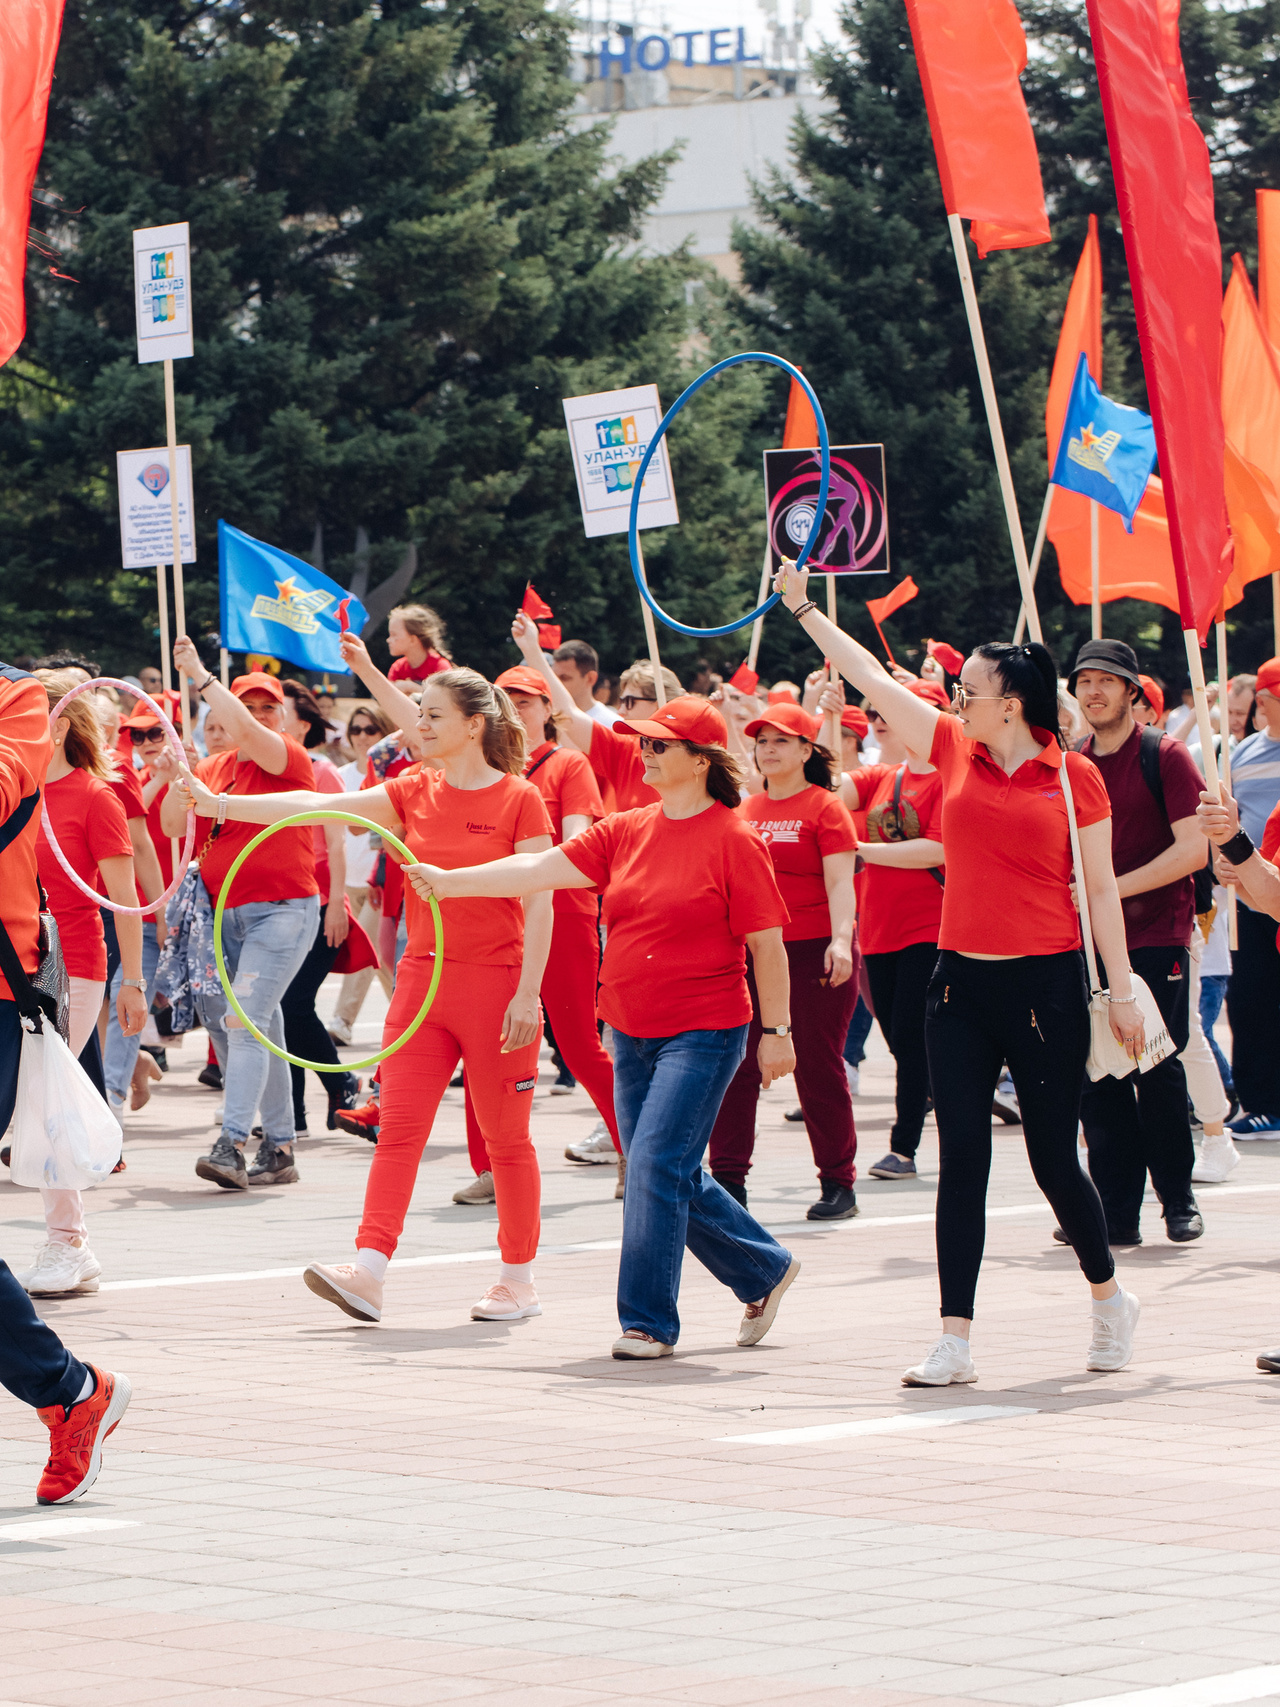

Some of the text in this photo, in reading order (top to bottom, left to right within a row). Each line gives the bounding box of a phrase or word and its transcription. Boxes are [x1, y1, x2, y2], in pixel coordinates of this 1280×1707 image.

[600, 27, 761, 78] HOTEL
[141, 278, 184, 295] УЛАН-УДЭ
[583, 443, 657, 465] УЛАН-УД
[469, 823, 483, 832] just
[760, 820, 803, 831] ARMOUR
